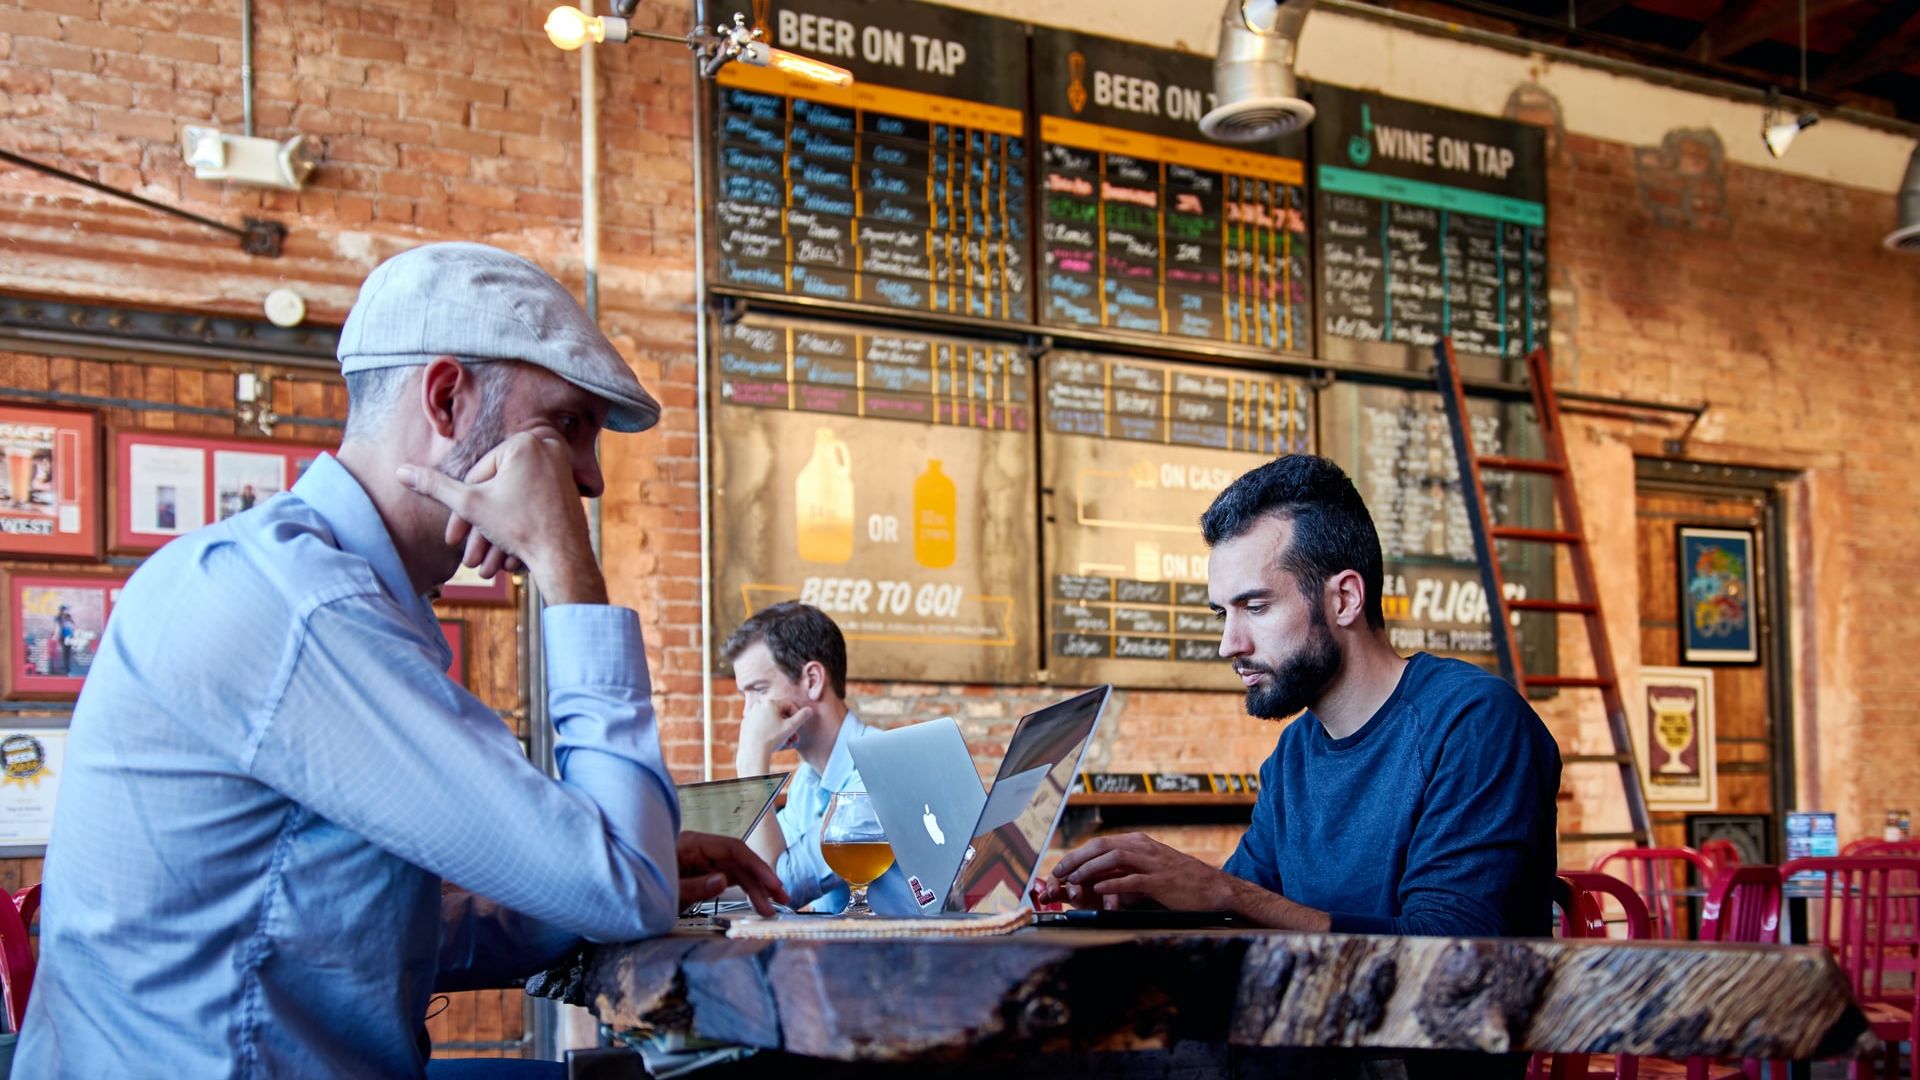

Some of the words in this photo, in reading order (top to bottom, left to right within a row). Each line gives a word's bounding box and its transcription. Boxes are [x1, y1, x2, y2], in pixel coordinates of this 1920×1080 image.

[778, 9, 856, 58] BEER
[862, 26, 904, 67] ON
[910, 35, 966, 76] TAP
[1094, 70, 1160, 116] BEER
[1166, 85, 1202, 122] ON
[1374, 125, 1435, 166] WINE
[1438, 137, 1471, 172] ON
[1472, 143, 1515, 180] TAP
[1160, 463, 1186, 489] ON
[868, 514, 899, 543] OR
[1163, 554, 1188, 579] ON
[801, 577, 870, 614] BEER
[876, 580, 910, 618] TO
[915, 583, 963, 619] GO!
